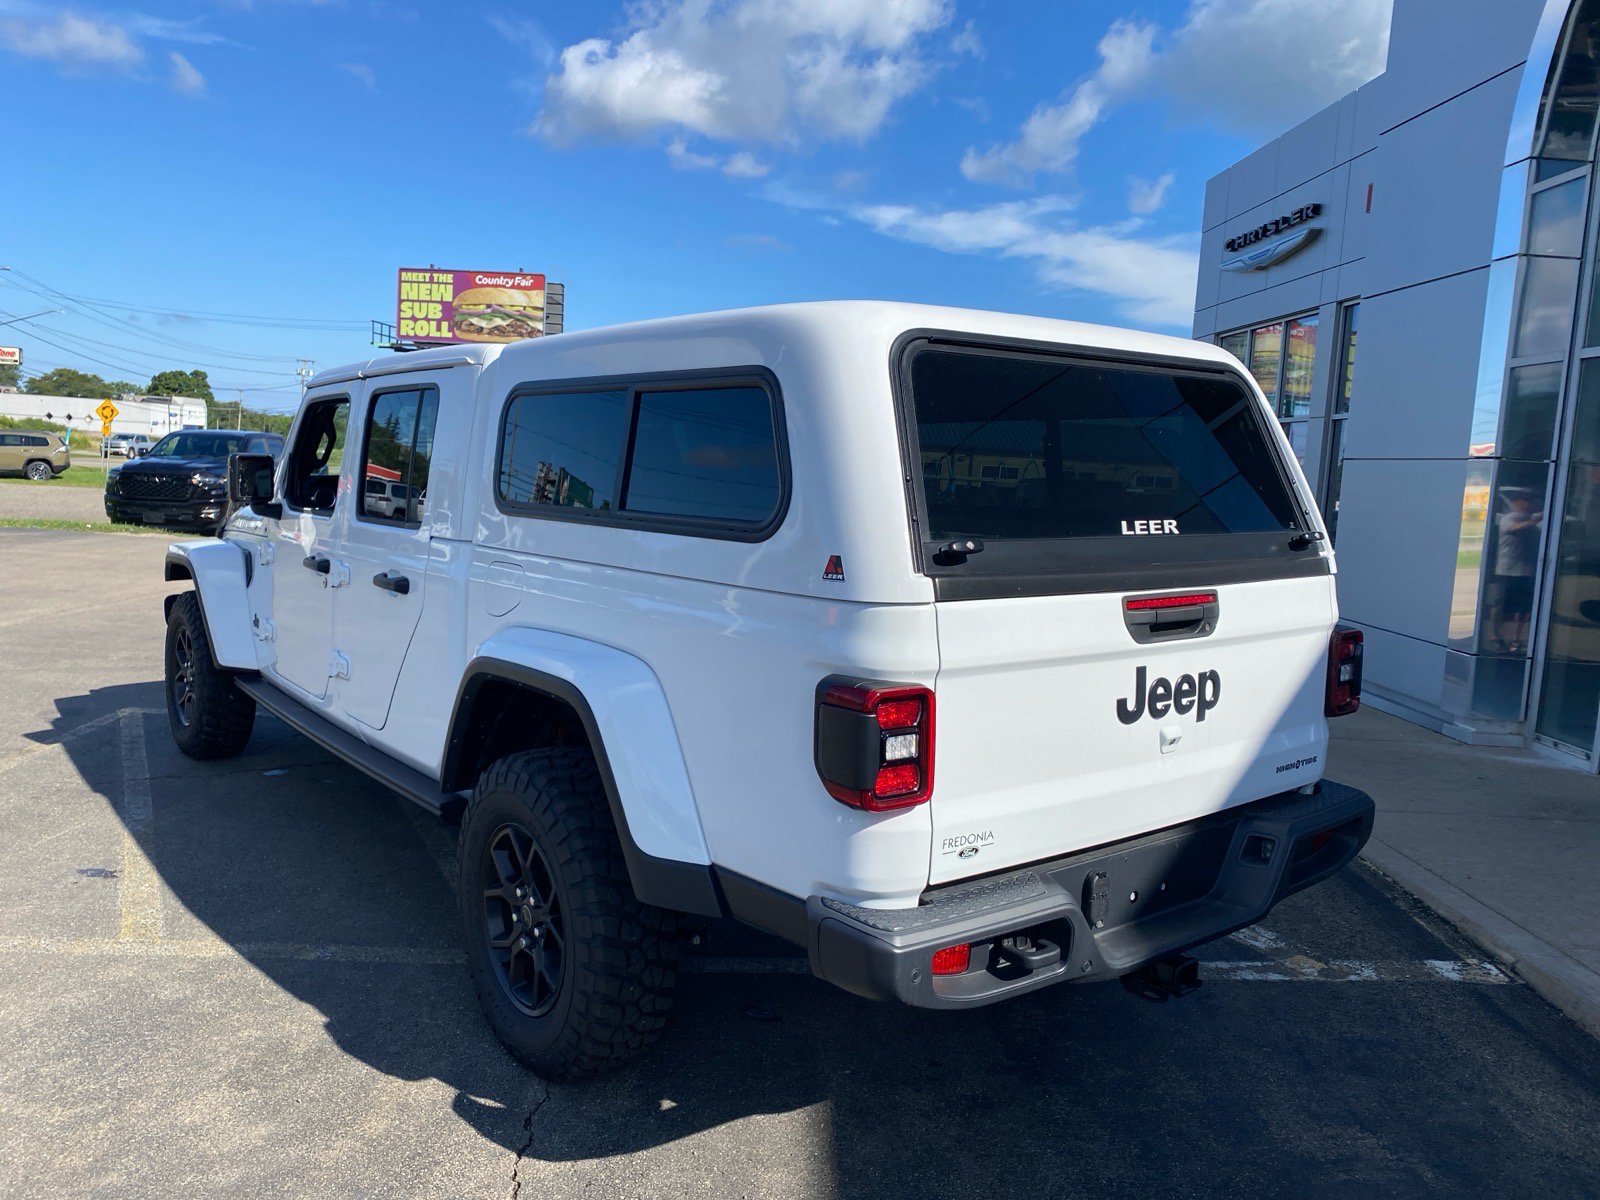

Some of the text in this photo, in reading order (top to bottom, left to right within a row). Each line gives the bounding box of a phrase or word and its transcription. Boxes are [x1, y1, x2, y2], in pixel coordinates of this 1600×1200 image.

[1225, 203, 1322, 252] CHRYSLER
[401, 271, 453, 283] MEET THE
[475, 275, 534, 287] Country Fair
[401, 282, 453, 302] NEW
[400, 301, 443, 319] SUB
[400, 319, 453, 338] ROLL
[1120, 519, 1180, 535] LEER
[1116, 665, 1221, 725] Jeep
[942, 830, 995, 849] FREDONIA
